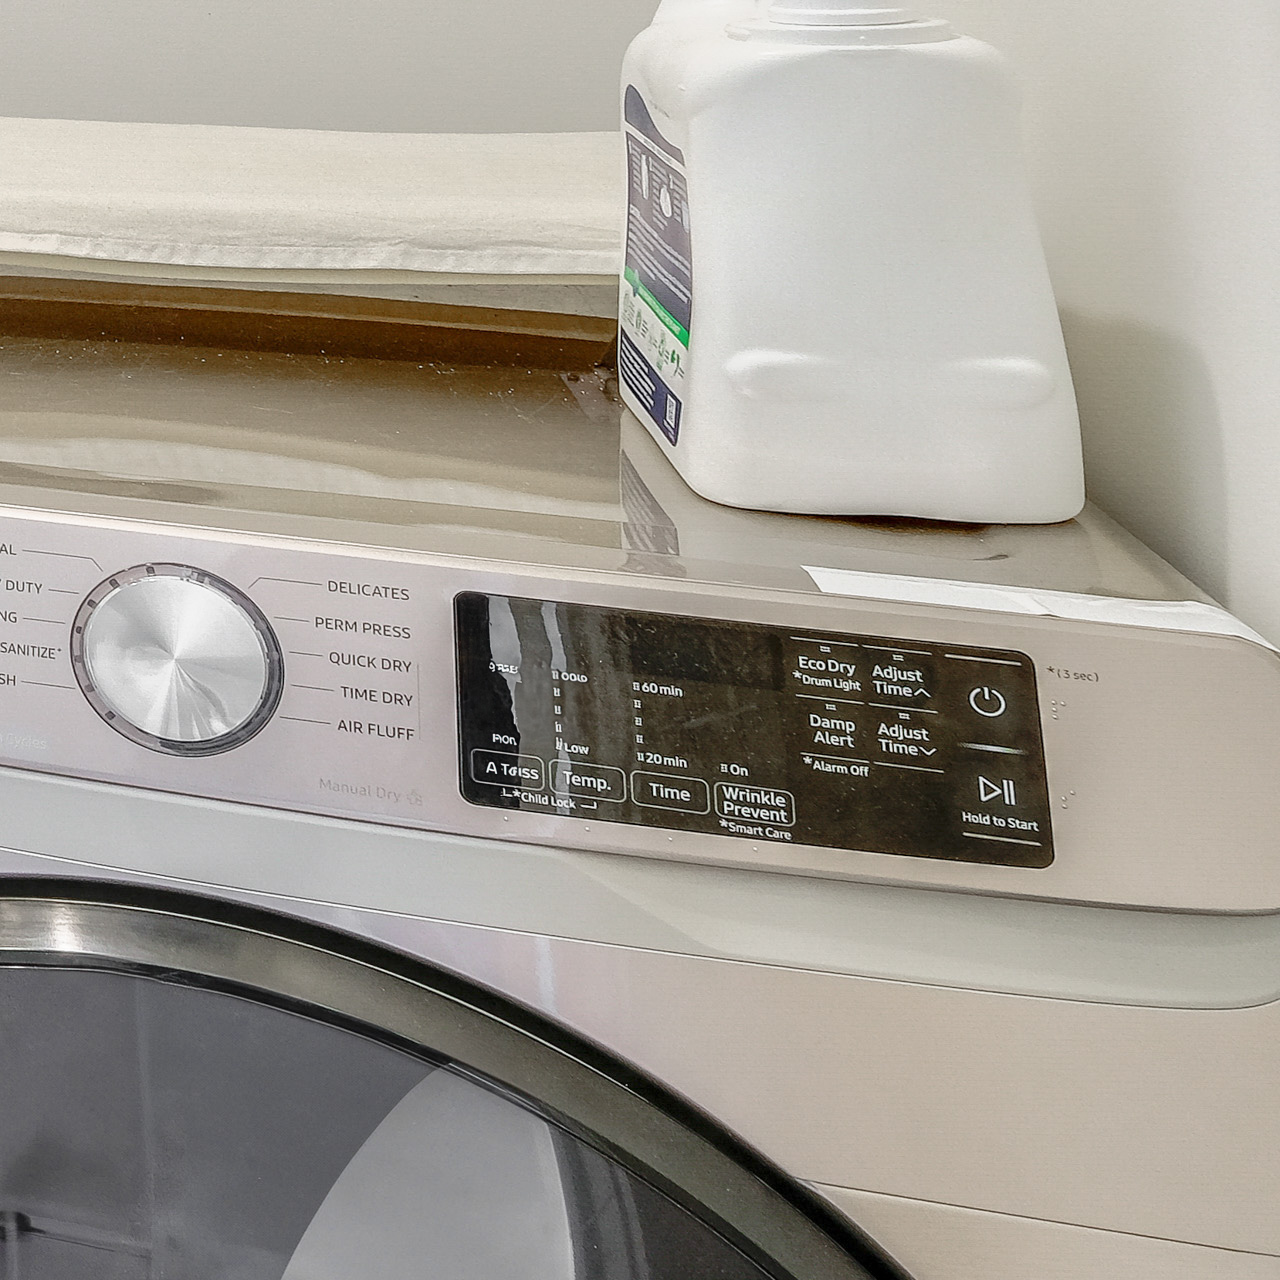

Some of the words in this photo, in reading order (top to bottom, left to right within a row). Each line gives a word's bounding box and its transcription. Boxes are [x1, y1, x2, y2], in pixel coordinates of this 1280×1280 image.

[6, 578, 43, 596] DUTY
[327, 580, 410, 602] DELICATES
[314, 616, 359, 634] PERM
[362, 620, 411, 640] PRESS
[329, 651, 378, 670] QUICK
[380, 656, 413, 675] DRY
[798, 655, 827, 672] Eco
[828, 659, 856, 677] Dry
[833, 676, 862, 692] Light
[872, 664, 924, 685] Adjust
[1073, 671, 1100, 684] sec)
[340, 685, 380, 704] TIME
[382, 689, 414, 708] DRY
[873, 680, 913, 698] Time
[337, 718, 364, 734] AIR
[367, 721, 415, 742] FLUFF
[809, 714, 856, 734] Damp
[878, 722, 930, 742] Adjust
[814, 731, 855, 749] Alert
[878, 739, 919, 757] Time
[729, 763, 749, 777] On
[850, 764, 870, 778] Off
[319, 778, 371, 797] Manual
[376, 786, 400, 803] Dry
[563, 771, 612, 791] Temp.
[551, 794, 576, 809] Lock
[648, 782, 691, 801] Time
[722, 785, 786, 807] Wrinkle
[723, 801, 788, 823] Prevent
[962, 811, 991, 826] Hold
[993, 815, 1006, 827] to
[1007, 817, 1040, 833] Start
[765, 827, 792, 840] Care
